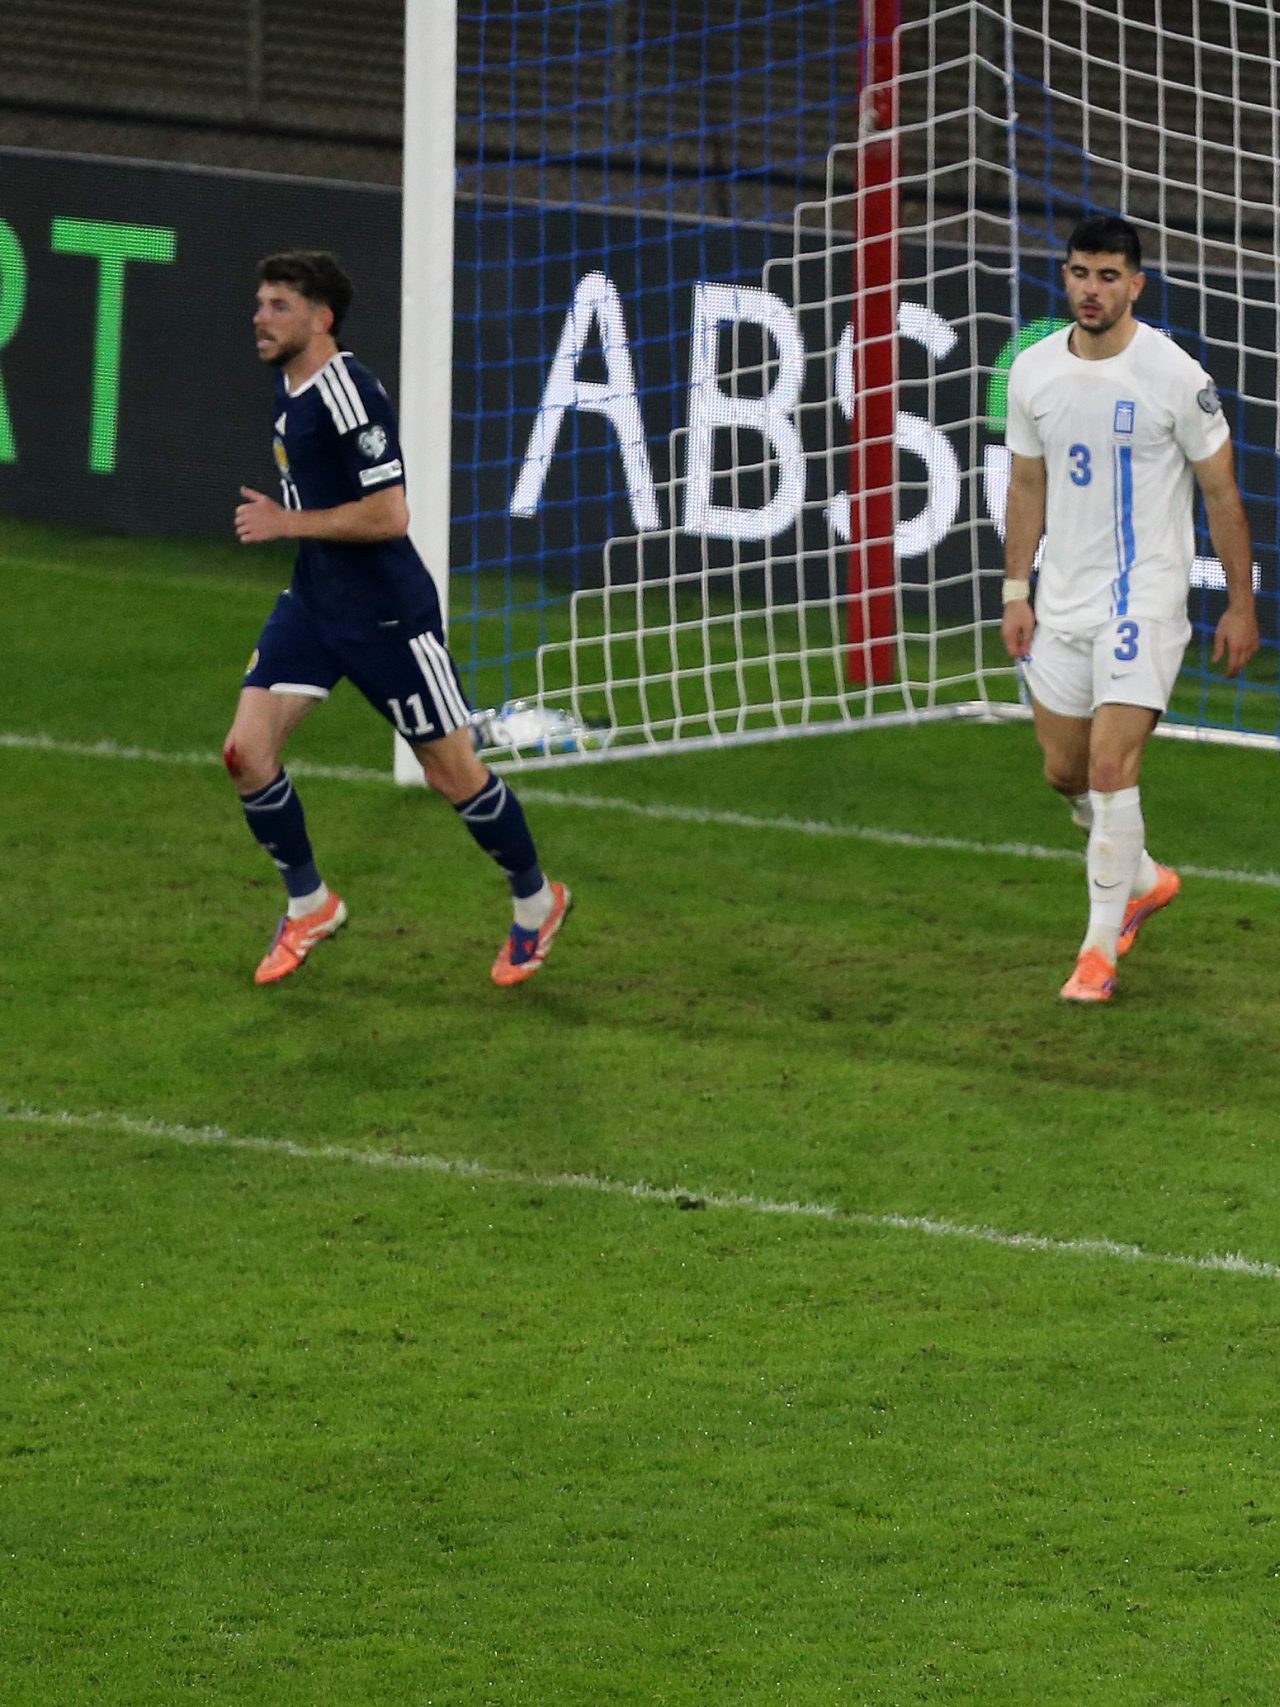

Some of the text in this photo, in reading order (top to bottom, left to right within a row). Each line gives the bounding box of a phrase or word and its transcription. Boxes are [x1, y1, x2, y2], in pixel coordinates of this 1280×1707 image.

[0, 215, 177, 474] T
[1069, 443, 1092, 487] 3
[1113, 620, 1140, 661] 3
[387, 693, 435, 736] 11
